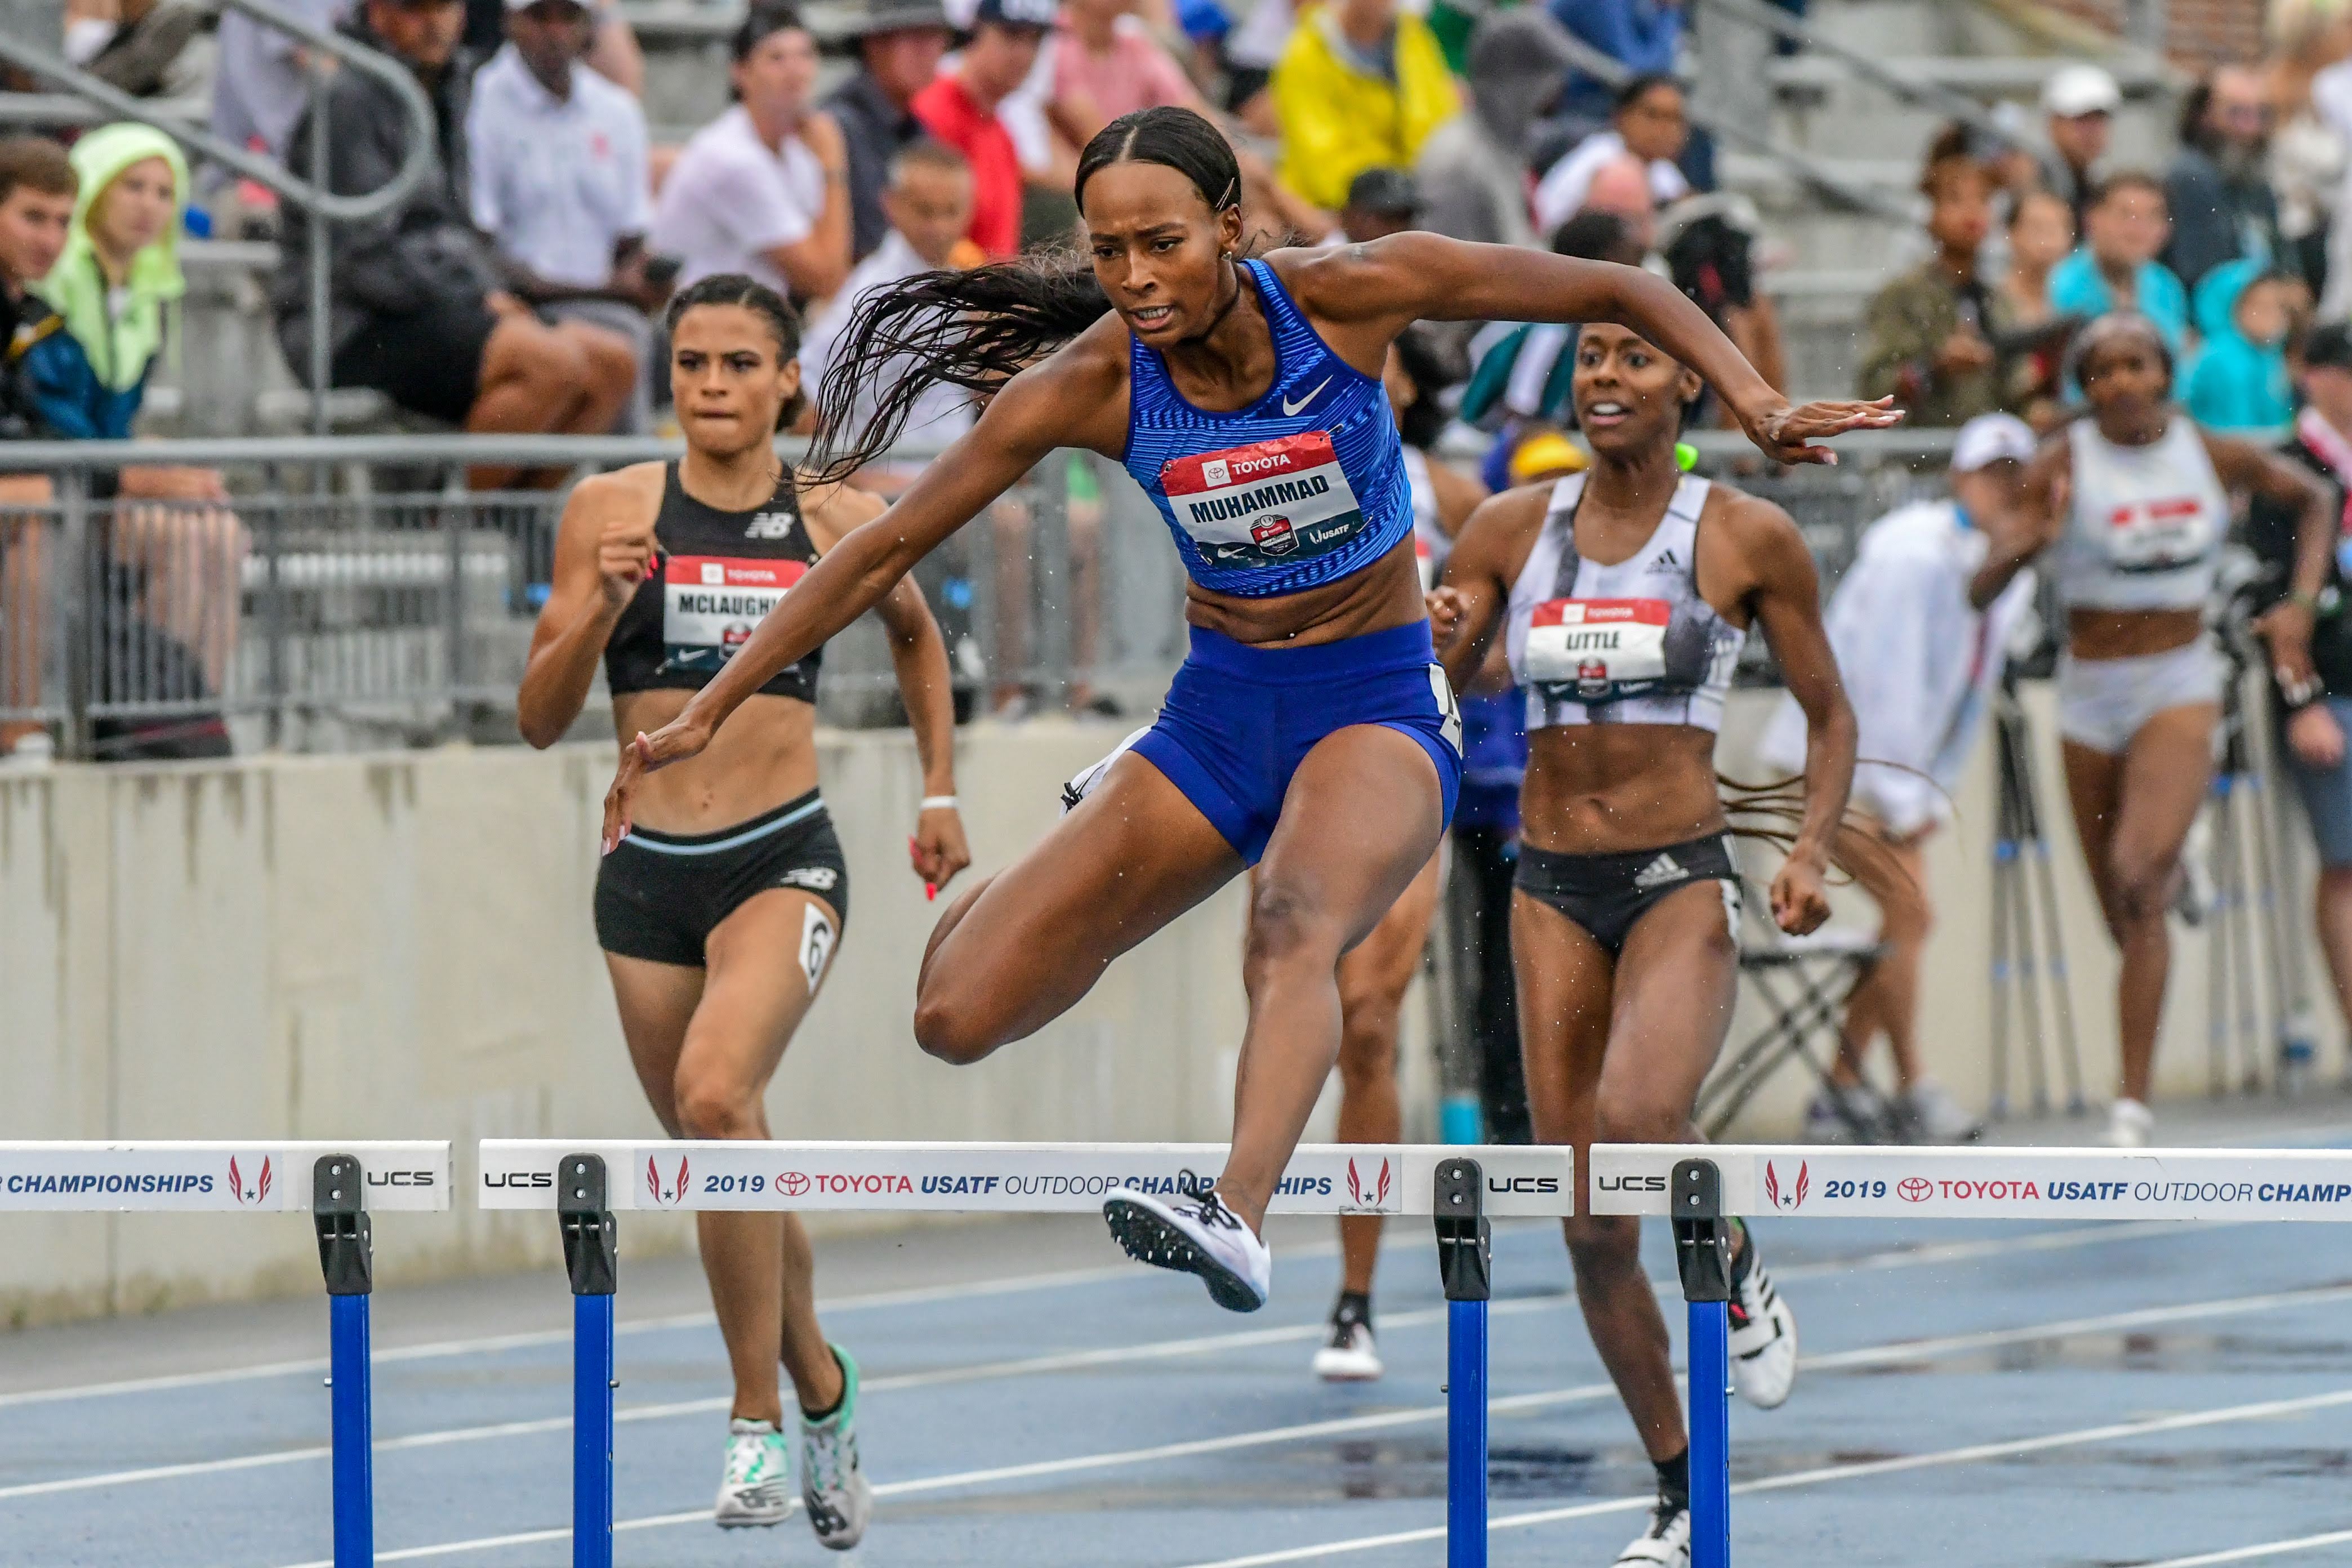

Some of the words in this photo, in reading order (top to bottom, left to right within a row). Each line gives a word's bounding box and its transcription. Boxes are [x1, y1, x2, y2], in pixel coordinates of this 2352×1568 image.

[1232, 454, 1291, 475] TOYOTA
[1188, 475, 1330, 523] MUHAMMAD
[1323, 524, 1349, 540] USATF
[1566, 631, 1620, 649] LITTLE
[809, 921, 828, 978] 6
[7, 1174, 213, 1193] CHAMPIONSHIPS
[368, 1171, 434, 1186] UCS
[485, 1172, 552, 1187] UCS
[704, 1175, 765, 1193] 2019
[816, 1175, 913, 1193] TOYOTA
[921, 1175, 999, 1193] USATF
[1489, 1177, 1559, 1193] UCS
[1599, 1177, 1667, 1191] UCS
[1824, 1181, 1886, 1198] 2019
[1939, 1181, 2039, 1199] TOYOTA
[2048, 1182, 2129, 1200] USATF
[2135, 1183, 2253, 1202] OUTDOOR
[2258, 1183, 2352, 1202] CHAMP
